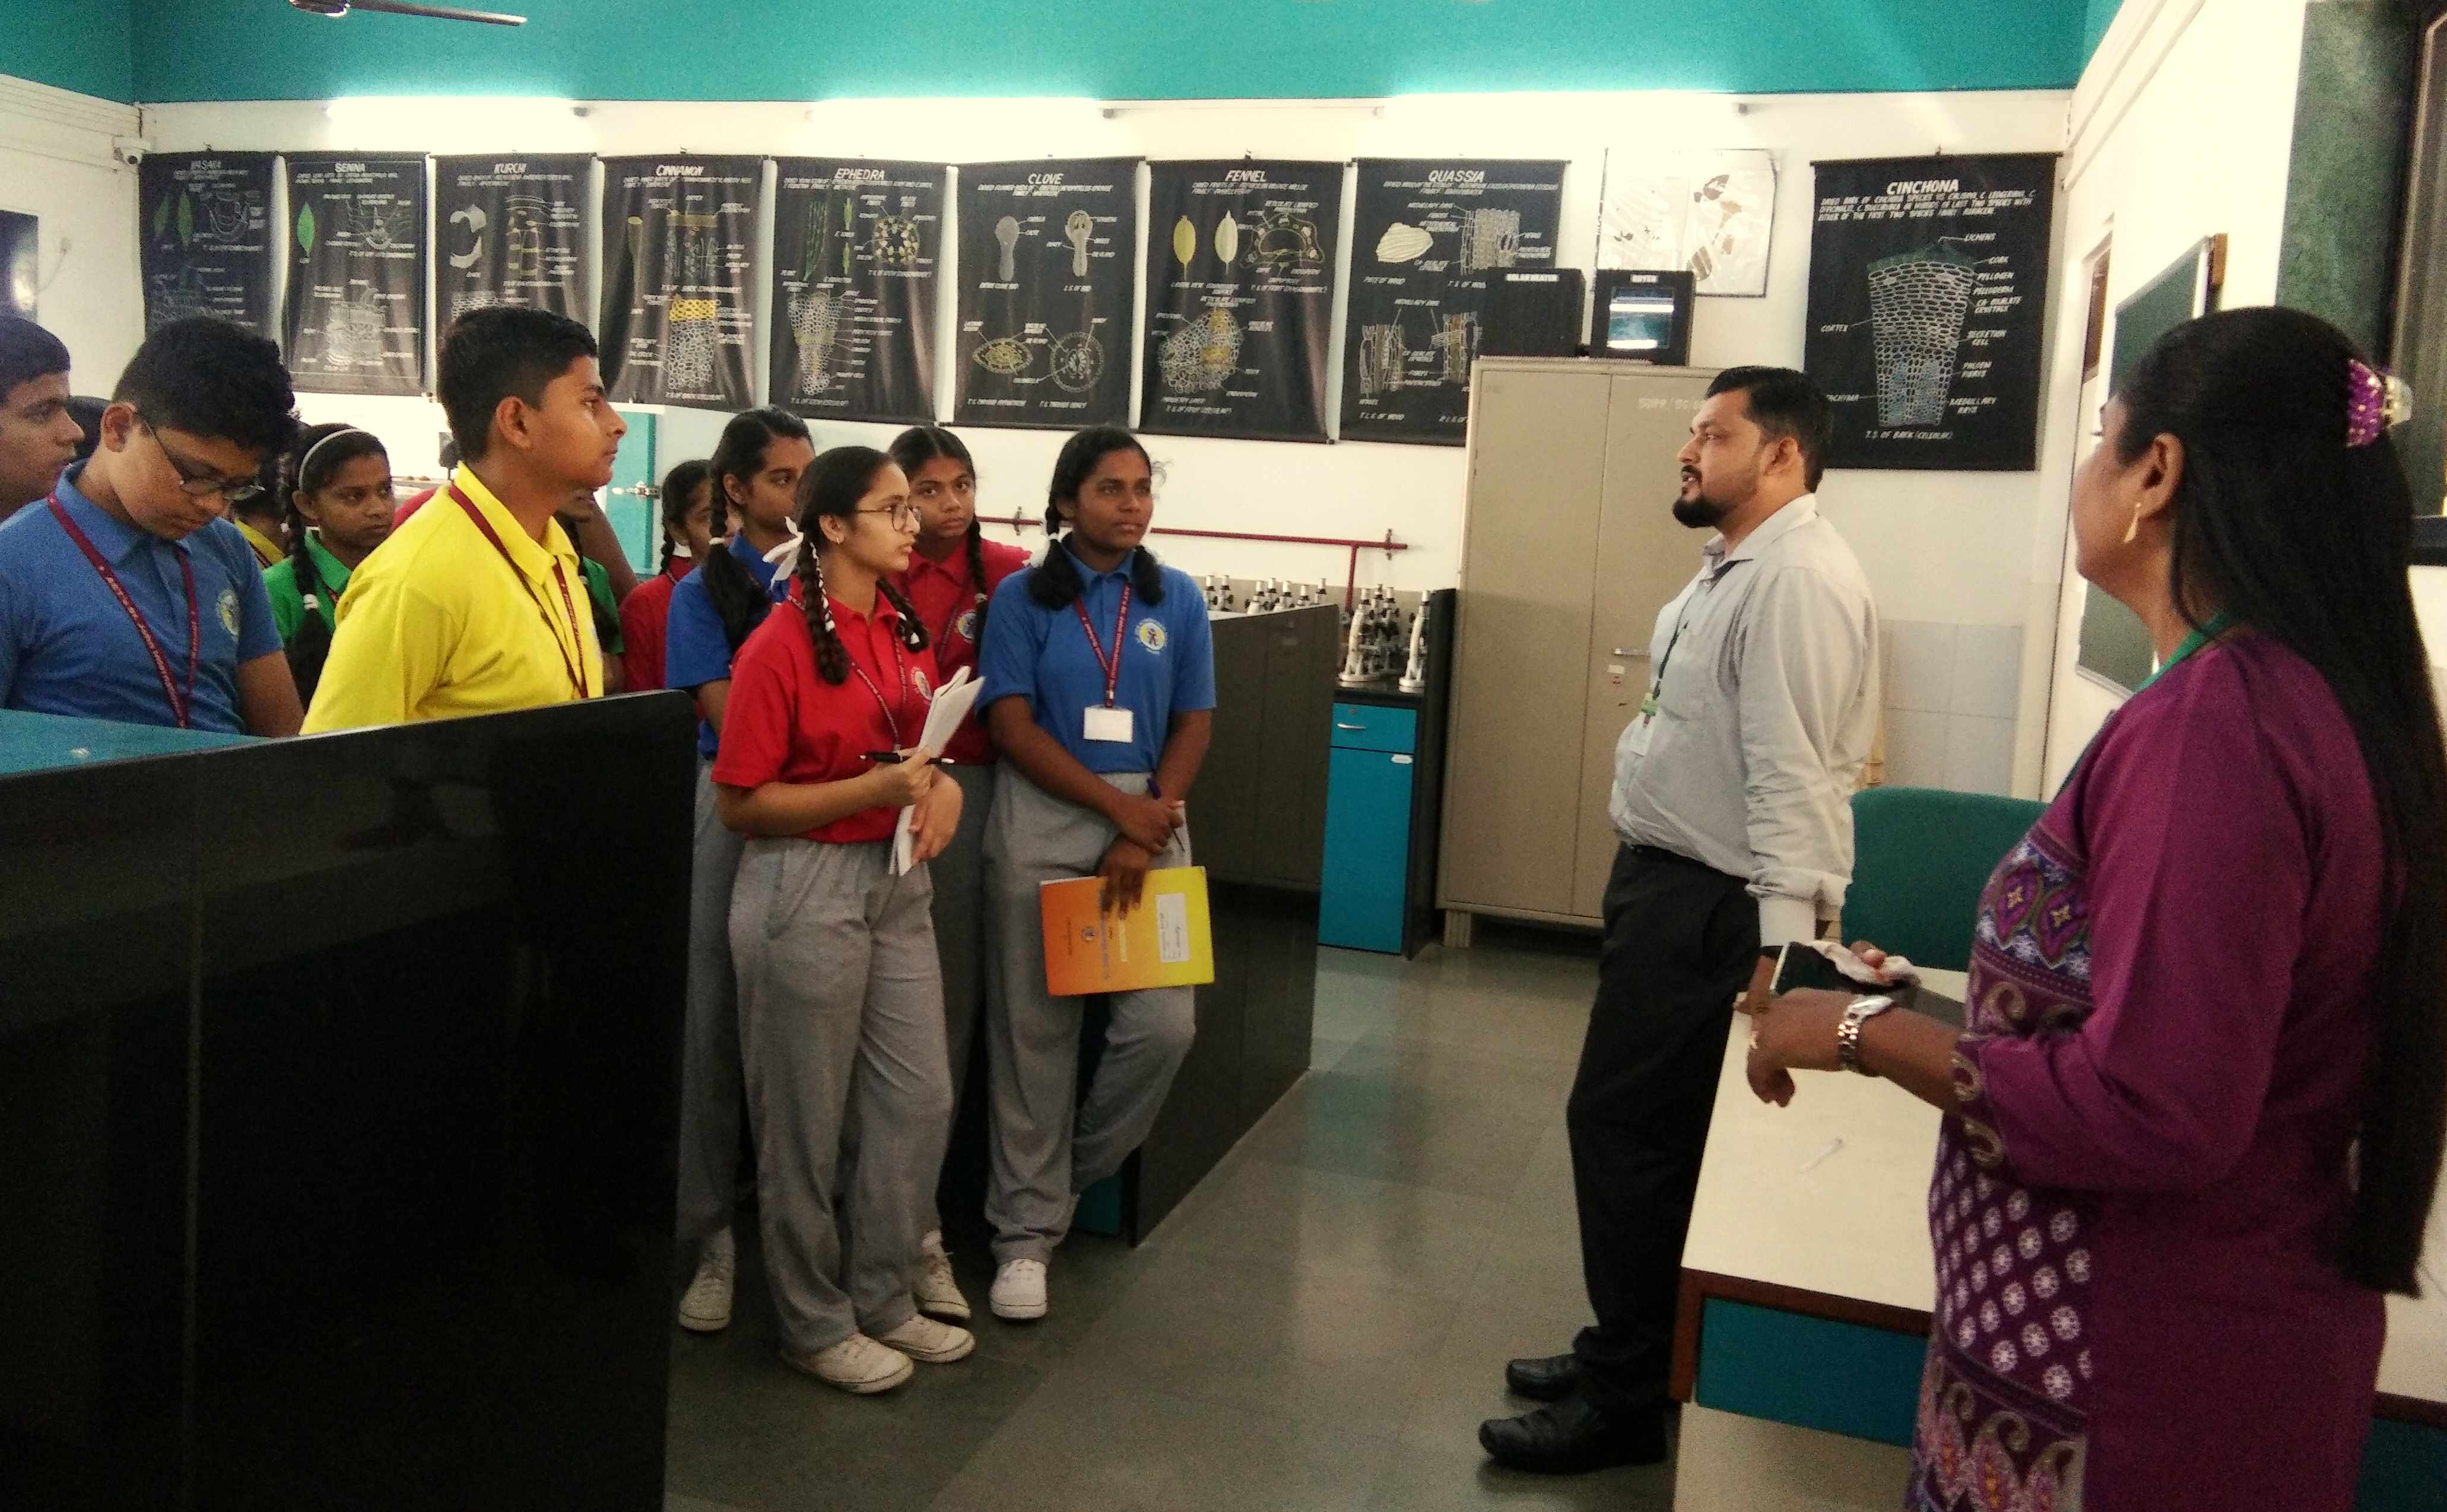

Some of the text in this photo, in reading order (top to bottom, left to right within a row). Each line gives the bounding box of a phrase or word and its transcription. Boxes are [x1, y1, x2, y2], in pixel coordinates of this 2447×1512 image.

[335, 163, 366, 172] SENNA
[656, 165, 704, 176] CINNAMON
[834, 168, 885, 180] EPHEDRA
[1028, 173, 1064, 184] CLOVE
[1224, 170, 1267, 182] FENNEL
[1428, 170, 1484, 182] QUASSIA
[1887, 179, 1959, 195] CINCHONA
